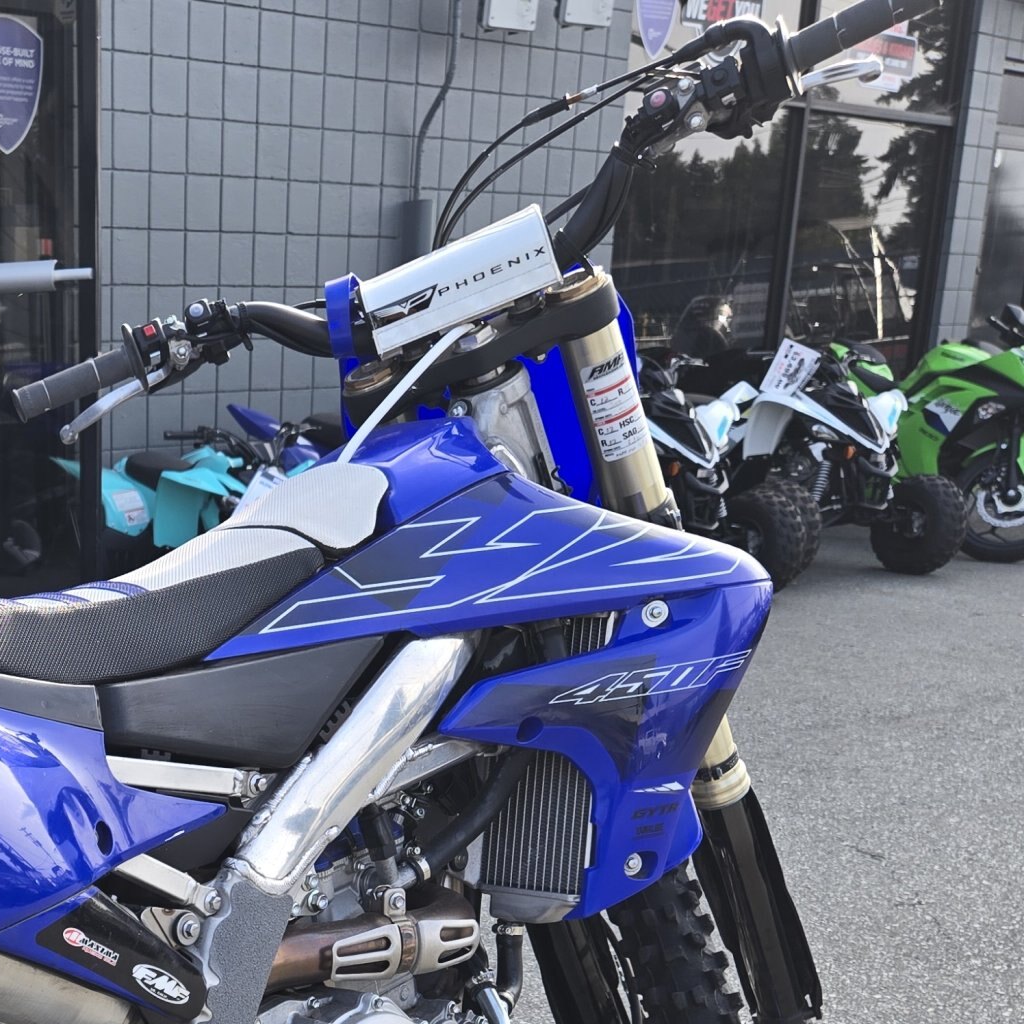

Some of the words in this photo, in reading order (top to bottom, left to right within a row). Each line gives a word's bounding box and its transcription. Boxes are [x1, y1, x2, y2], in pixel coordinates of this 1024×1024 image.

[686, 0, 707, 20] WE
[705, 0, 735, 21] GET
[736, 1, 761, 18] YOU
[2, 56, 14, 66] OF
[15, 58, 35, 69] MIND
[438, 246, 546, 297] PHOENIX
[549, 648, 753, 706] 450F
[79, 938, 119, 960] MAXIMA
[132, 965, 191, 999] FMF
